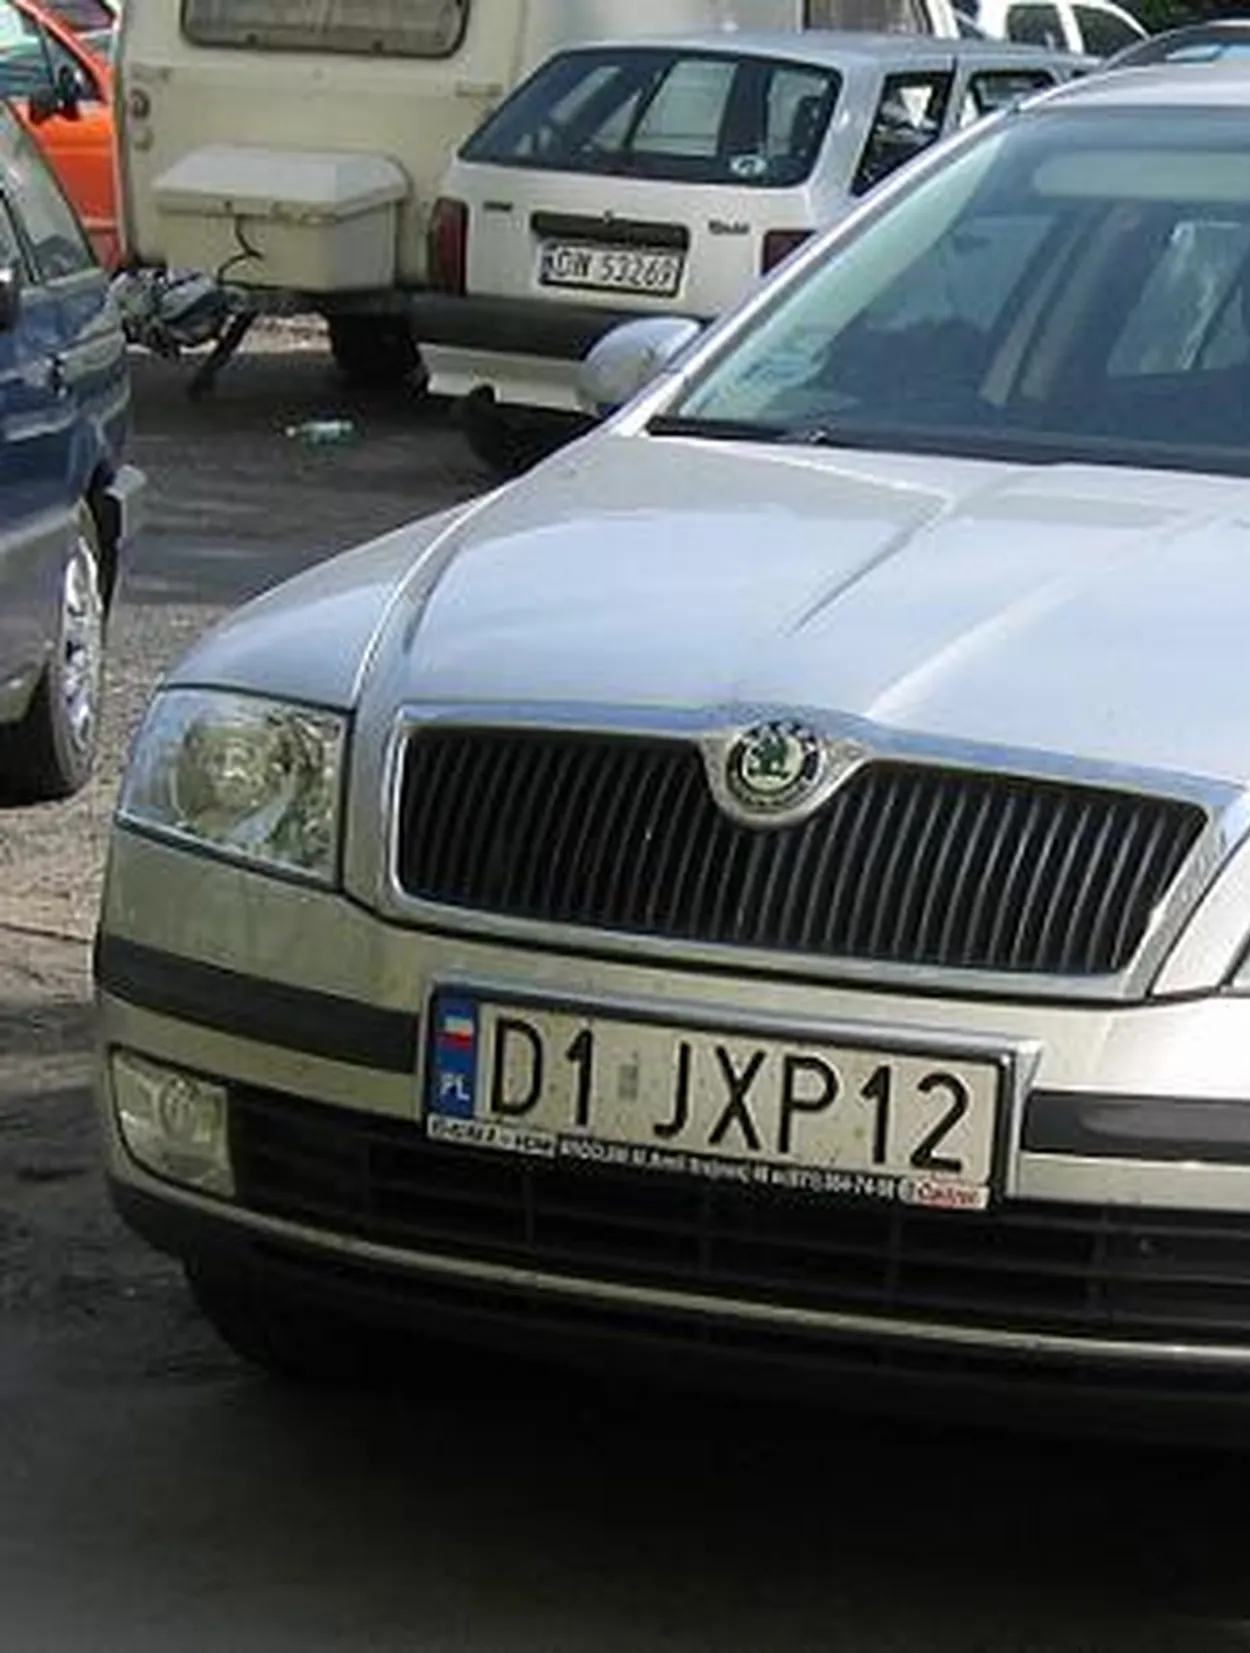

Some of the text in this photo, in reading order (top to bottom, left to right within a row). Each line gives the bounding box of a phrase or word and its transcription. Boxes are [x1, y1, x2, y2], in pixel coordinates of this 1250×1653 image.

[440, 1073, 470, 1101] PL
[491, 1018, 593, 1125] D1
[653, 1042, 969, 1172] JXP12
